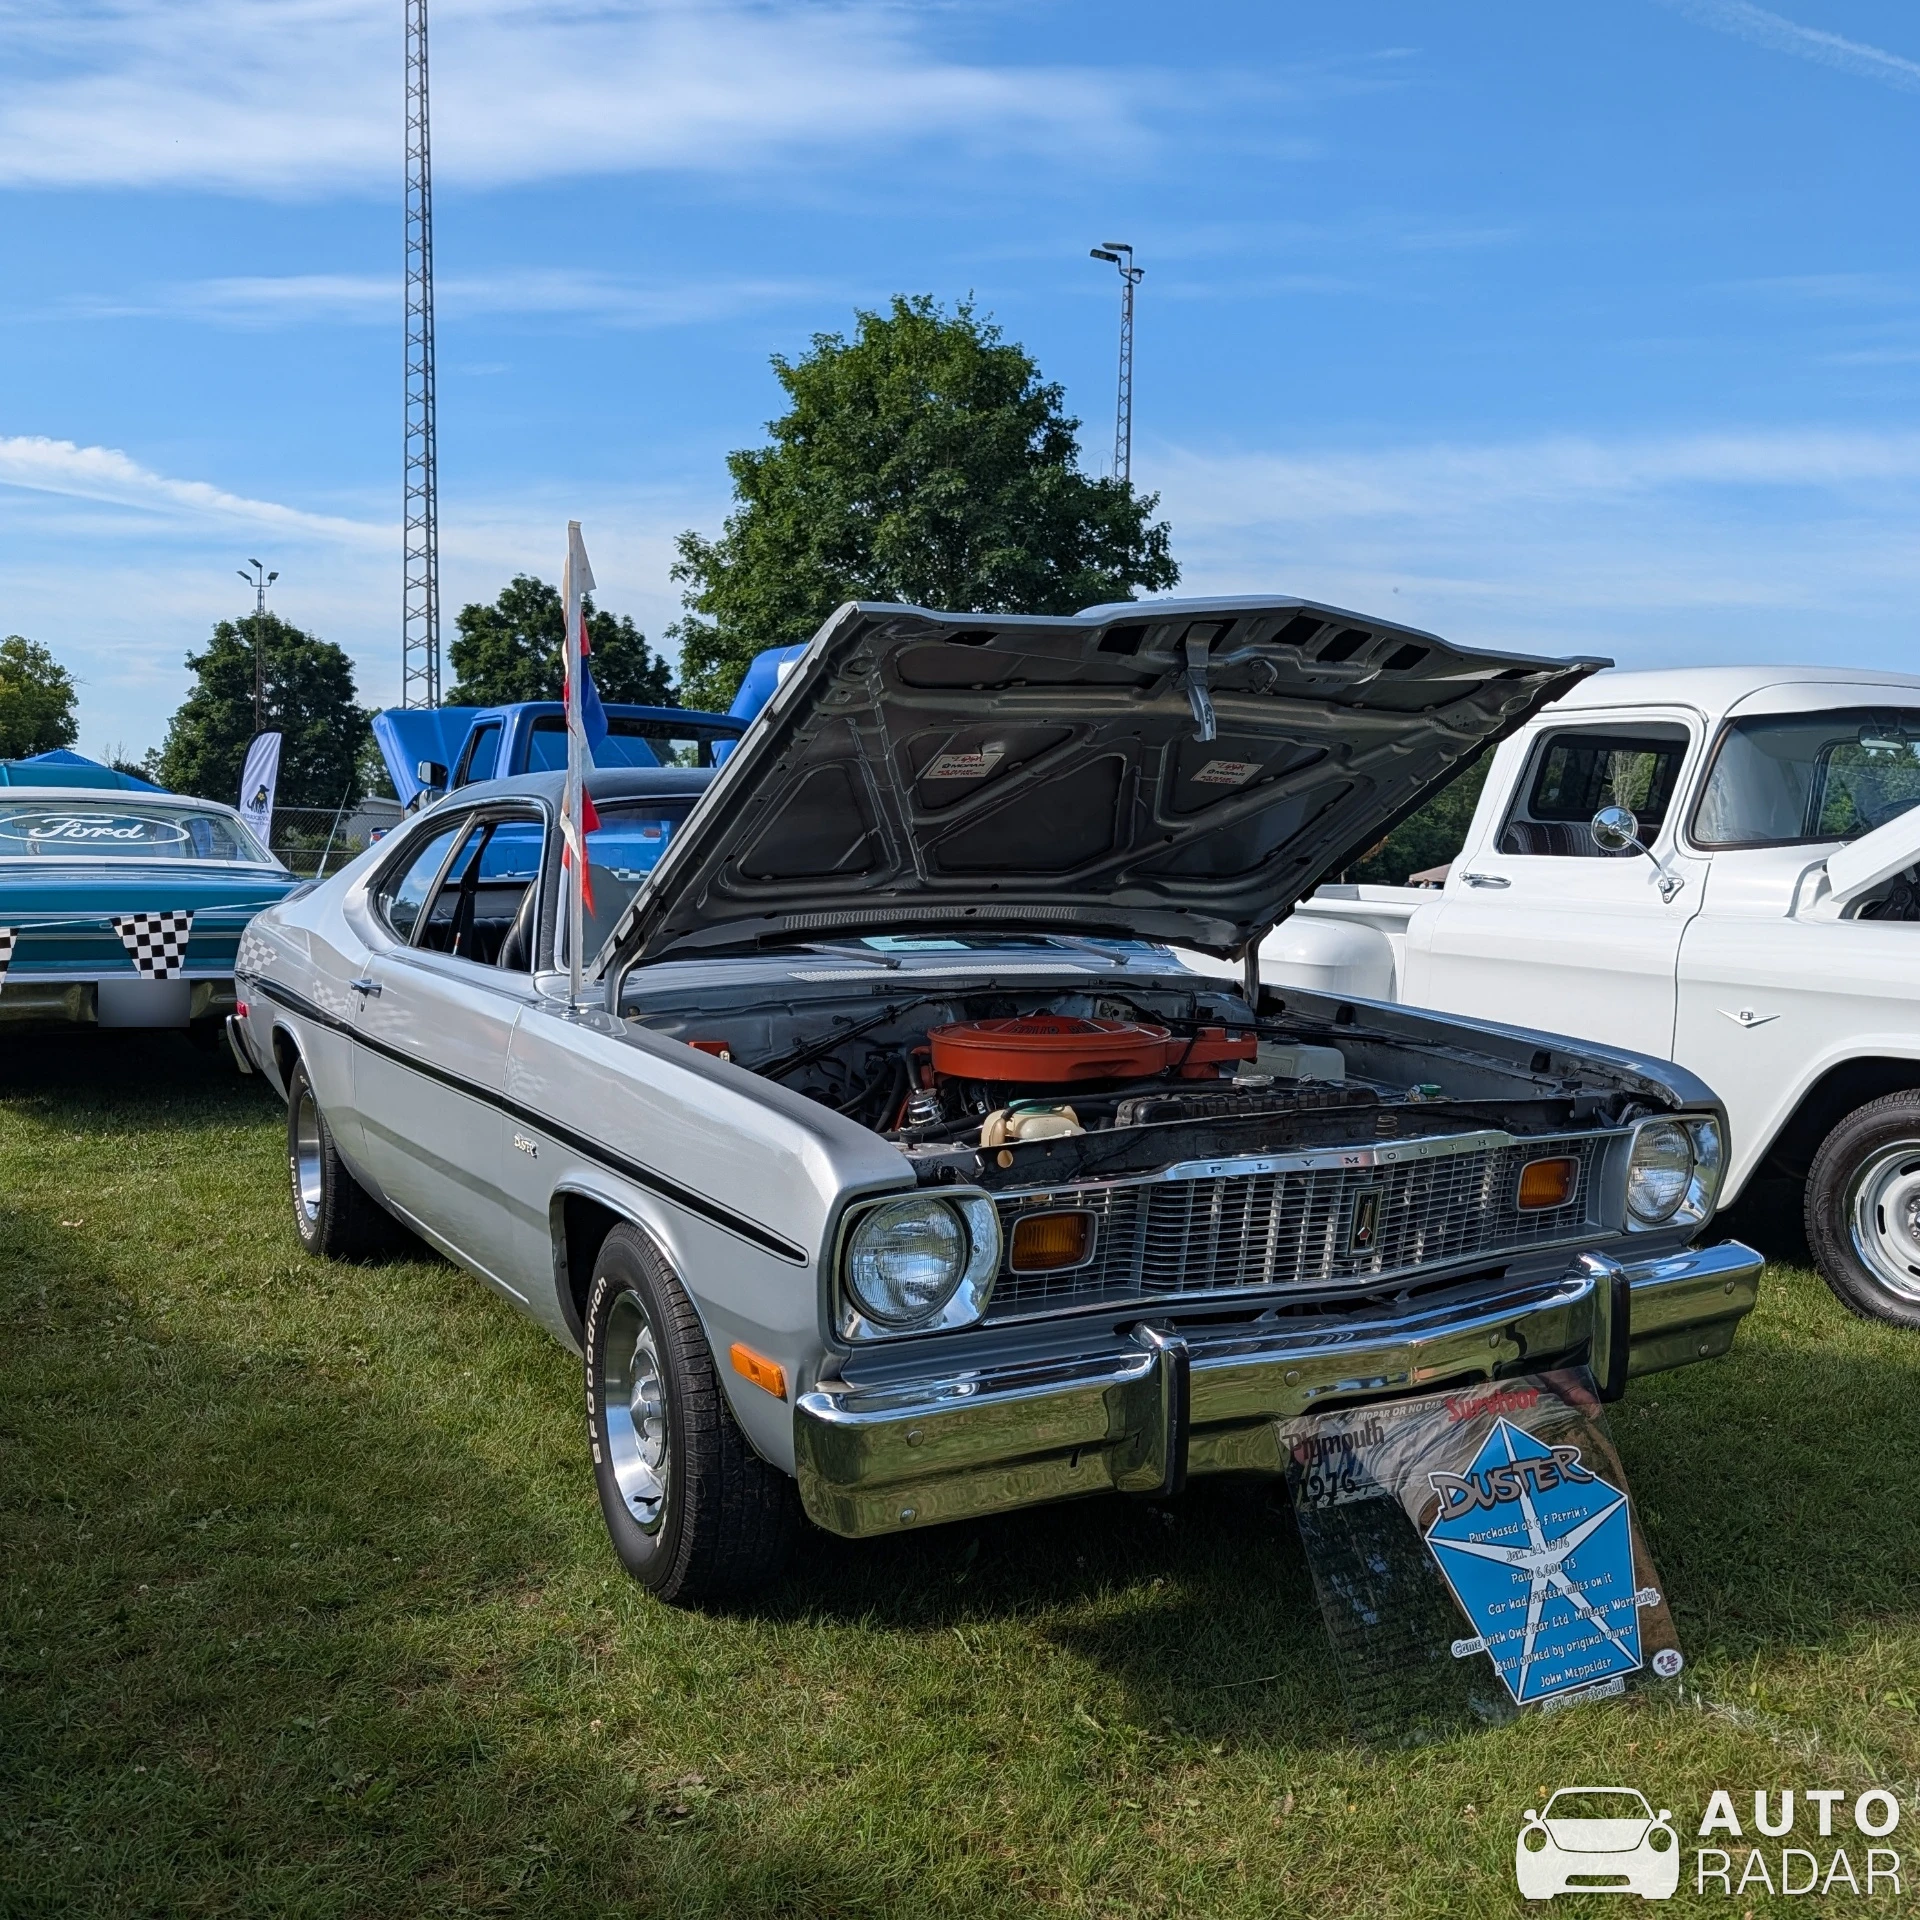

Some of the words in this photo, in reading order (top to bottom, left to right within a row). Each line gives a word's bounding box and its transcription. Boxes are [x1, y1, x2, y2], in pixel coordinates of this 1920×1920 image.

[29, 817, 145, 839] Ford
[1210, 1138, 1487, 1174] PLYMOUTH
[1357, 1409, 1391, 1421] MOPAR
[1392, 1406, 1406, 1417] OR
[1408, 1403, 1423, 1414] NO
[1445, 1387, 1540, 1423] Survivor
[1282, 1417, 1385, 1467] Plymouth
[1431, 1448, 1594, 1522] DUSTER
[1469, 1521, 1518, 1543] Purchased
[1521, 1518, 1533, 1530] at
[1506, 1549, 1528, 1562] Jan.
[1528, 1543, 1545, 1556] 24,
[1546, 1536, 1570, 1552] 1976
[1488, 1602, 1506, 1616] Car
[1509, 1595, 1527, 1610] had
[1564, 1581, 1589, 1595] miles
[1591, 1577, 1603, 1588] on
[1604, 1573, 1613, 1584] it
[1511, 1569, 1534, 1585] Paid
[1453, 1641, 1482, 1656] Came
[1483, 1630, 1507, 1647] with
[1508, 1627, 1527, 1641] One
[1574, 1603, 1610, 1622] Mileage
[1496, 1655, 1518, 1674] Still
[1520, 1649, 1550, 1666] owned
[1552, 1644, 1565, 1659] by
[1566, 1635, 1603, 1653] original
[1604, 1624, 1634, 1641] Owner
[1540, 1672, 1563, 1688] John
[1564, 1657, 1612, 1680] Meppelder
